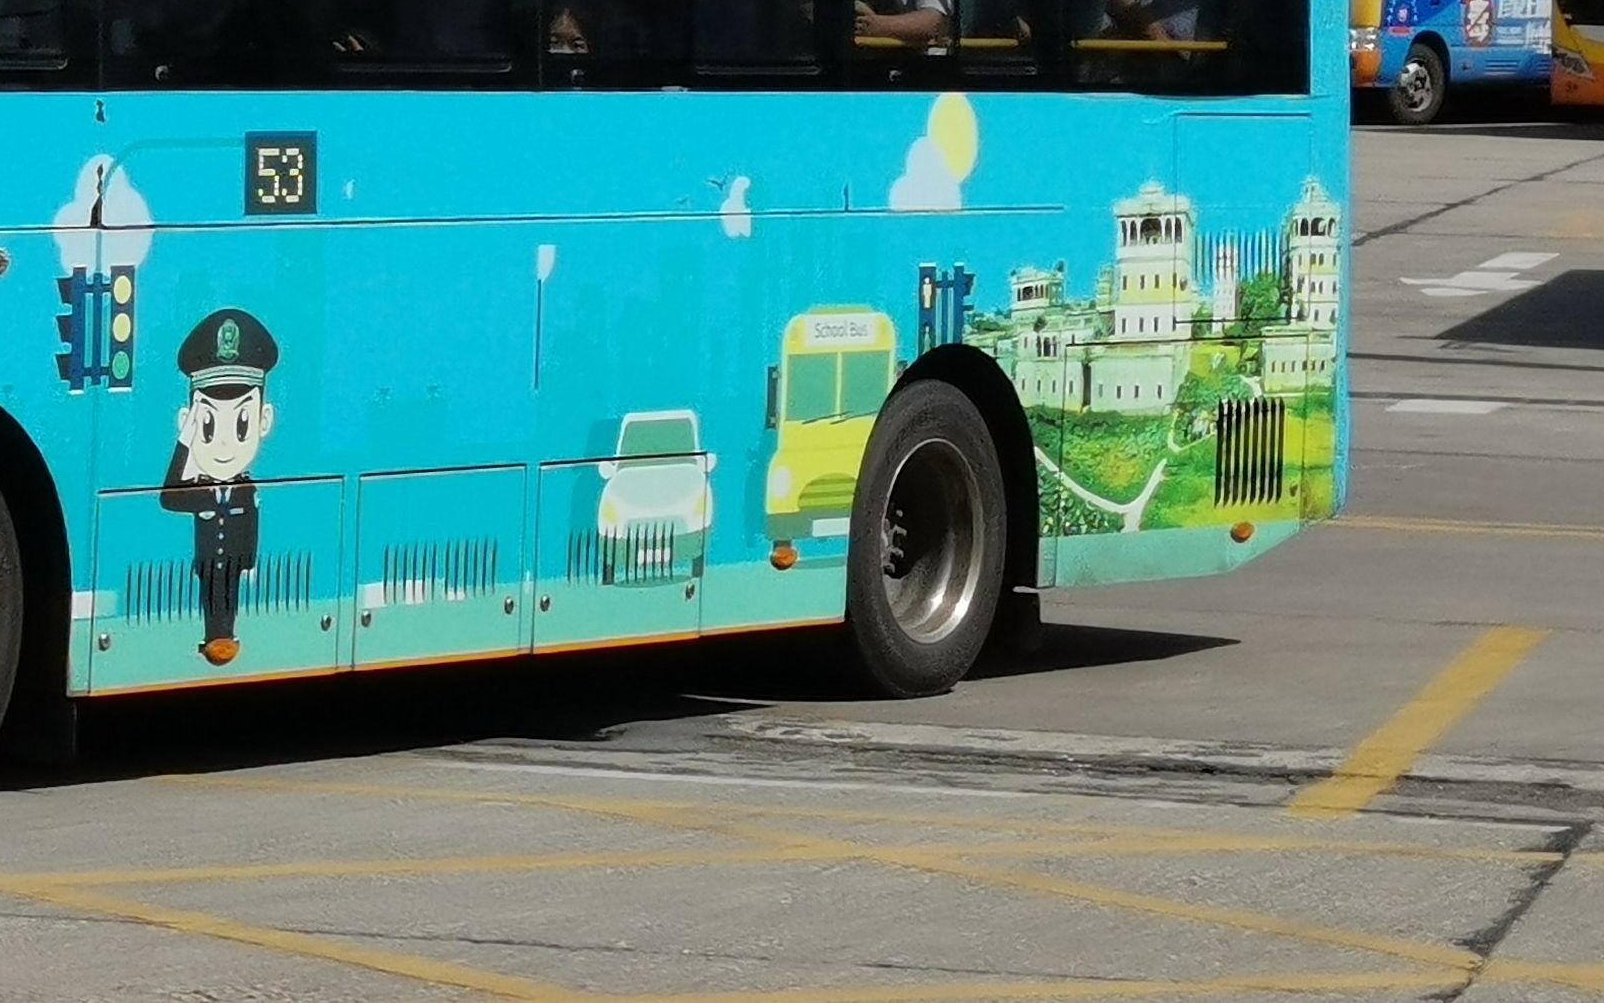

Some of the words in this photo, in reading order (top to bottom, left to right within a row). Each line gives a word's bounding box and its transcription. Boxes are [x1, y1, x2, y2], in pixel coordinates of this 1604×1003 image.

[256, 147, 304, 203] 53
[814, 322, 848, 339] School
[849, 321, 870, 338] Bus
